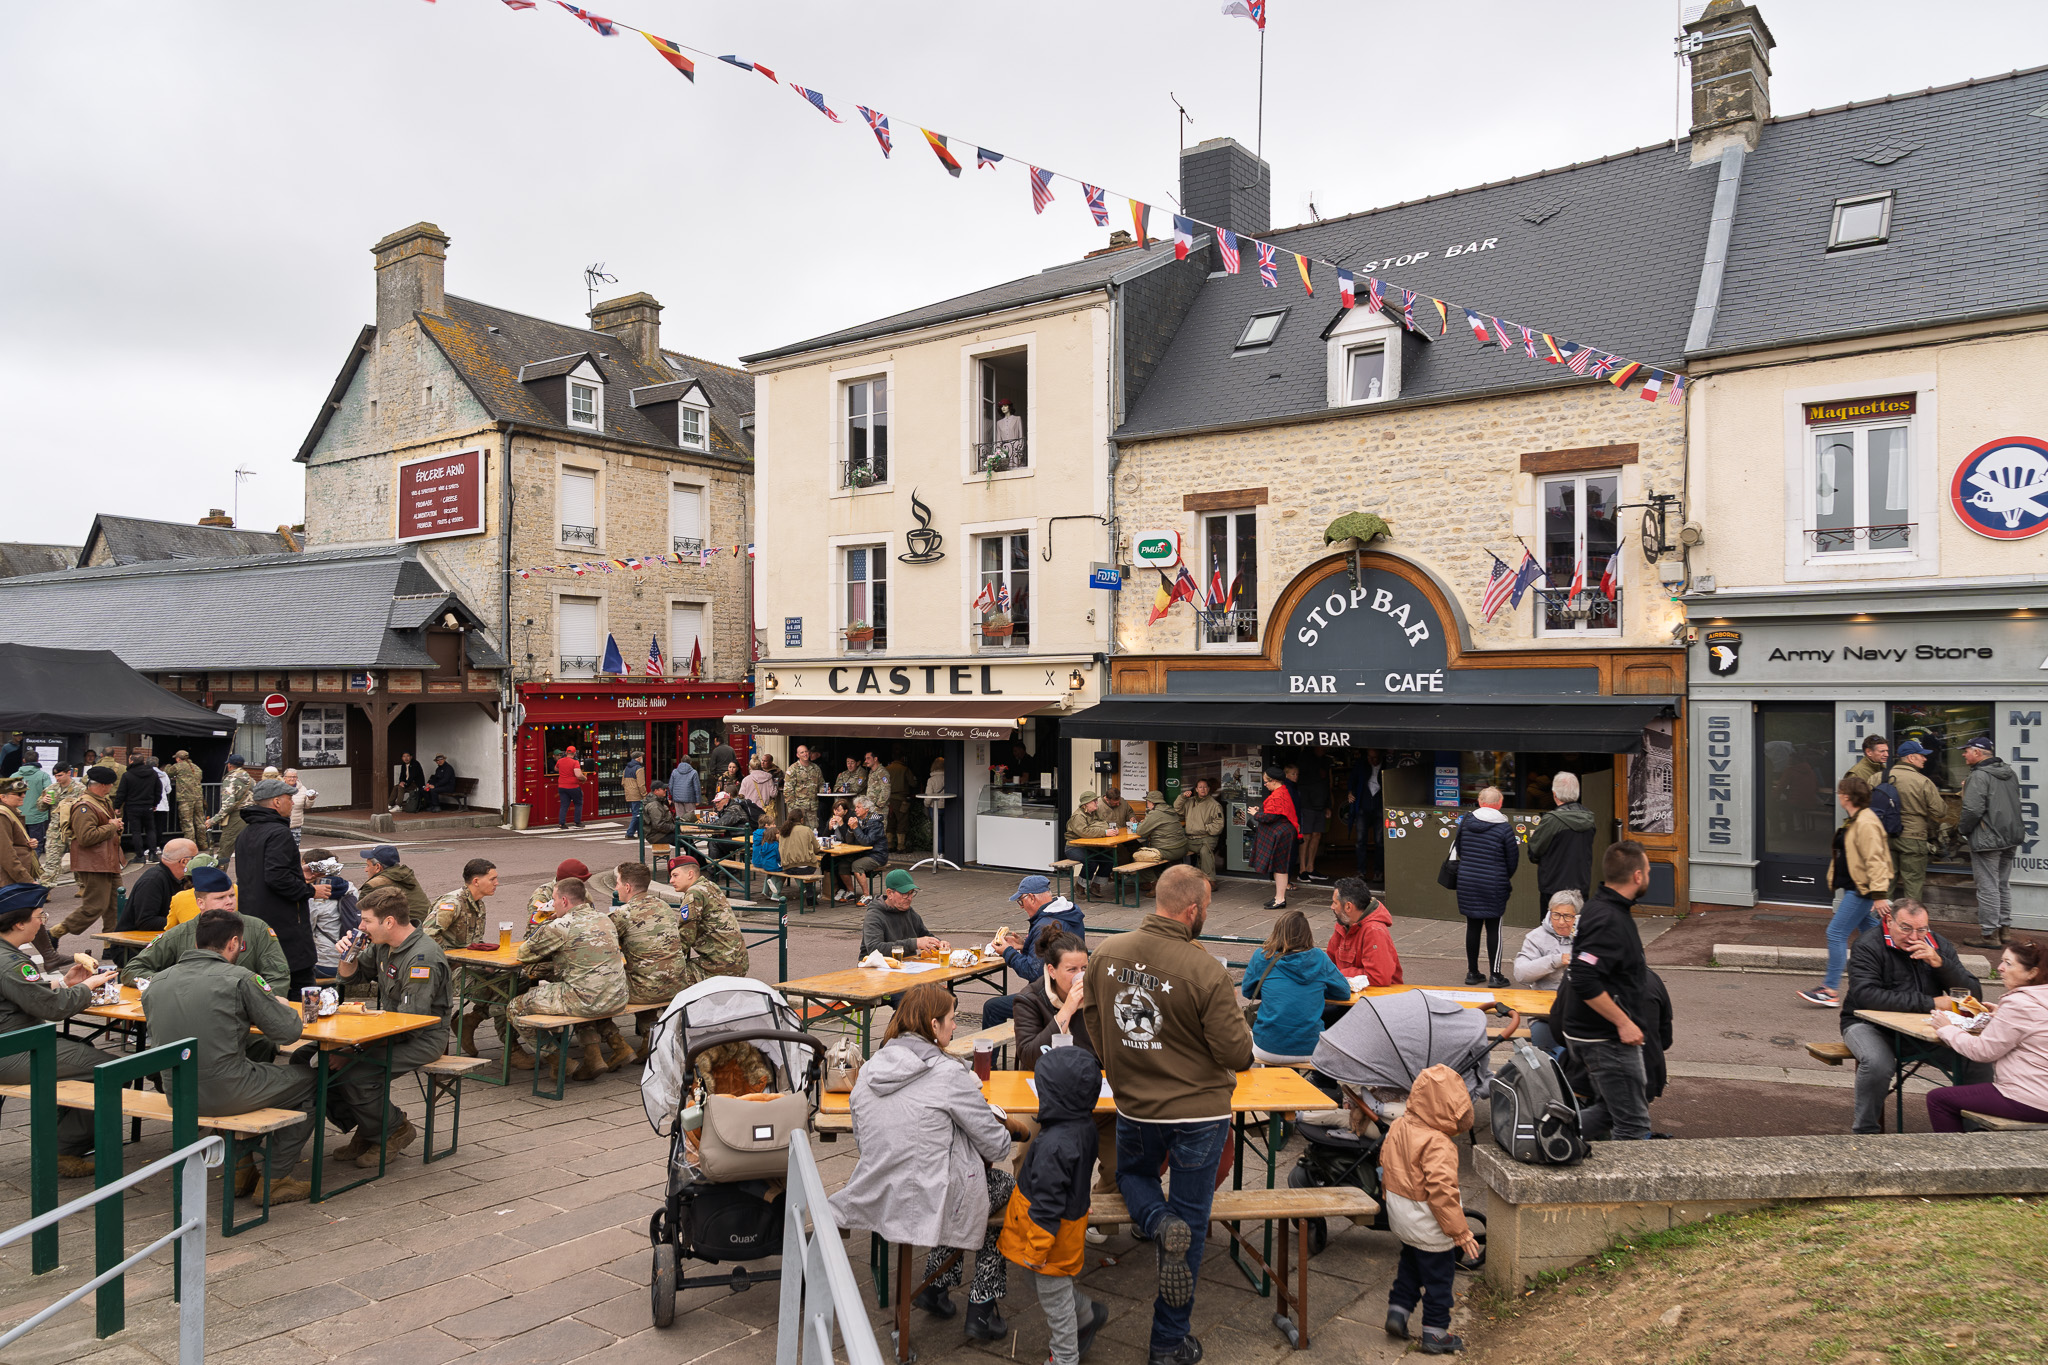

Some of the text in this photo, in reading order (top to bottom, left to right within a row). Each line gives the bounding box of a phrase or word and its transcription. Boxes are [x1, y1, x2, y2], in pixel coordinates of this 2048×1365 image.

[1362, 237, 1498, 273] STOP BAR
[1810, 400, 1910, 420] Maquettes
[416, 463, 464, 482] ÉPICERIE ARNO
[1141, 546, 1157, 554] PMU
[1097, 571, 1111, 581] FDJ
[1298, 587, 1430, 647] STOP BAR
[1708, 631, 1740, 639] AIRBORNE
[1768, 645, 1993, 663] Army Navy Store
[828, 666, 1003, 695] CASTEL
[1290, 675, 1337, 693] BAR
[1384, 669, 1444, 693] CAFÉ
[617, 697, 667, 708] EPICERIE ARNO
[732, 724, 779, 734] Bar Brasserie
[903, 727, 1001, 738] Glacier Crêpes Gaufres
[1274, 731, 1351, 747] STOP BAR
[1708, 716, 1732, 845] SOUVENIRS
[1117, 968, 1159, 991] JEEP
[1122, 1039, 1162, 1050] WILLYS MB
